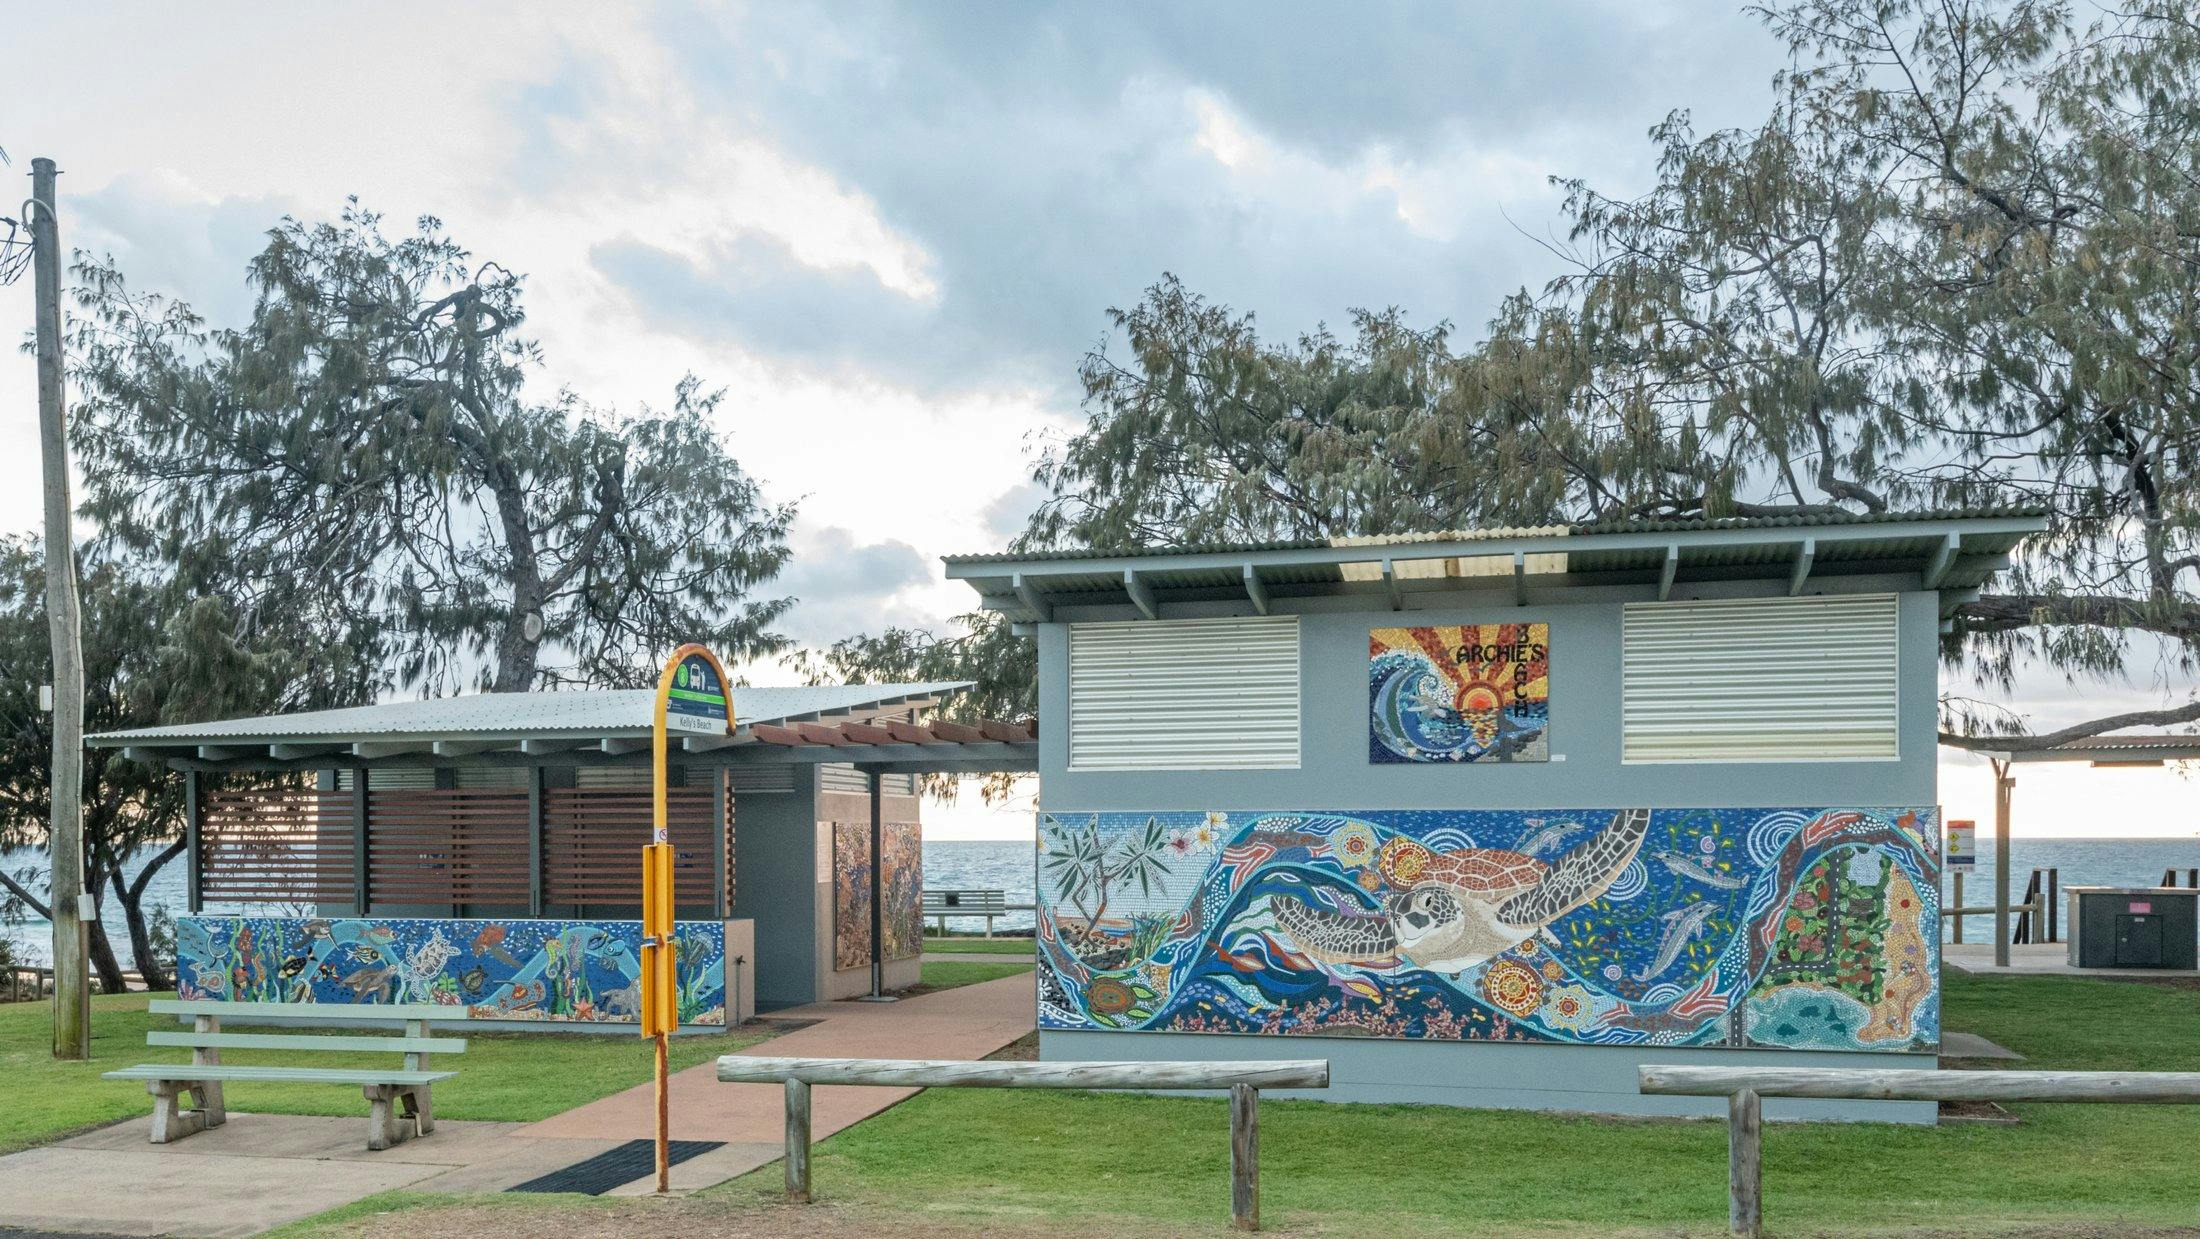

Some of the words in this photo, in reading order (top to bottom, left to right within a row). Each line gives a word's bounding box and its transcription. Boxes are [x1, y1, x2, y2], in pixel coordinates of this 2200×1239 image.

[1456, 643, 1545, 663] ARCHIE'S
[1514, 623, 1529, 718] BEACH
[680, 716, 696, 730] Kelly's
[697, 718, 712, 730] Beach
